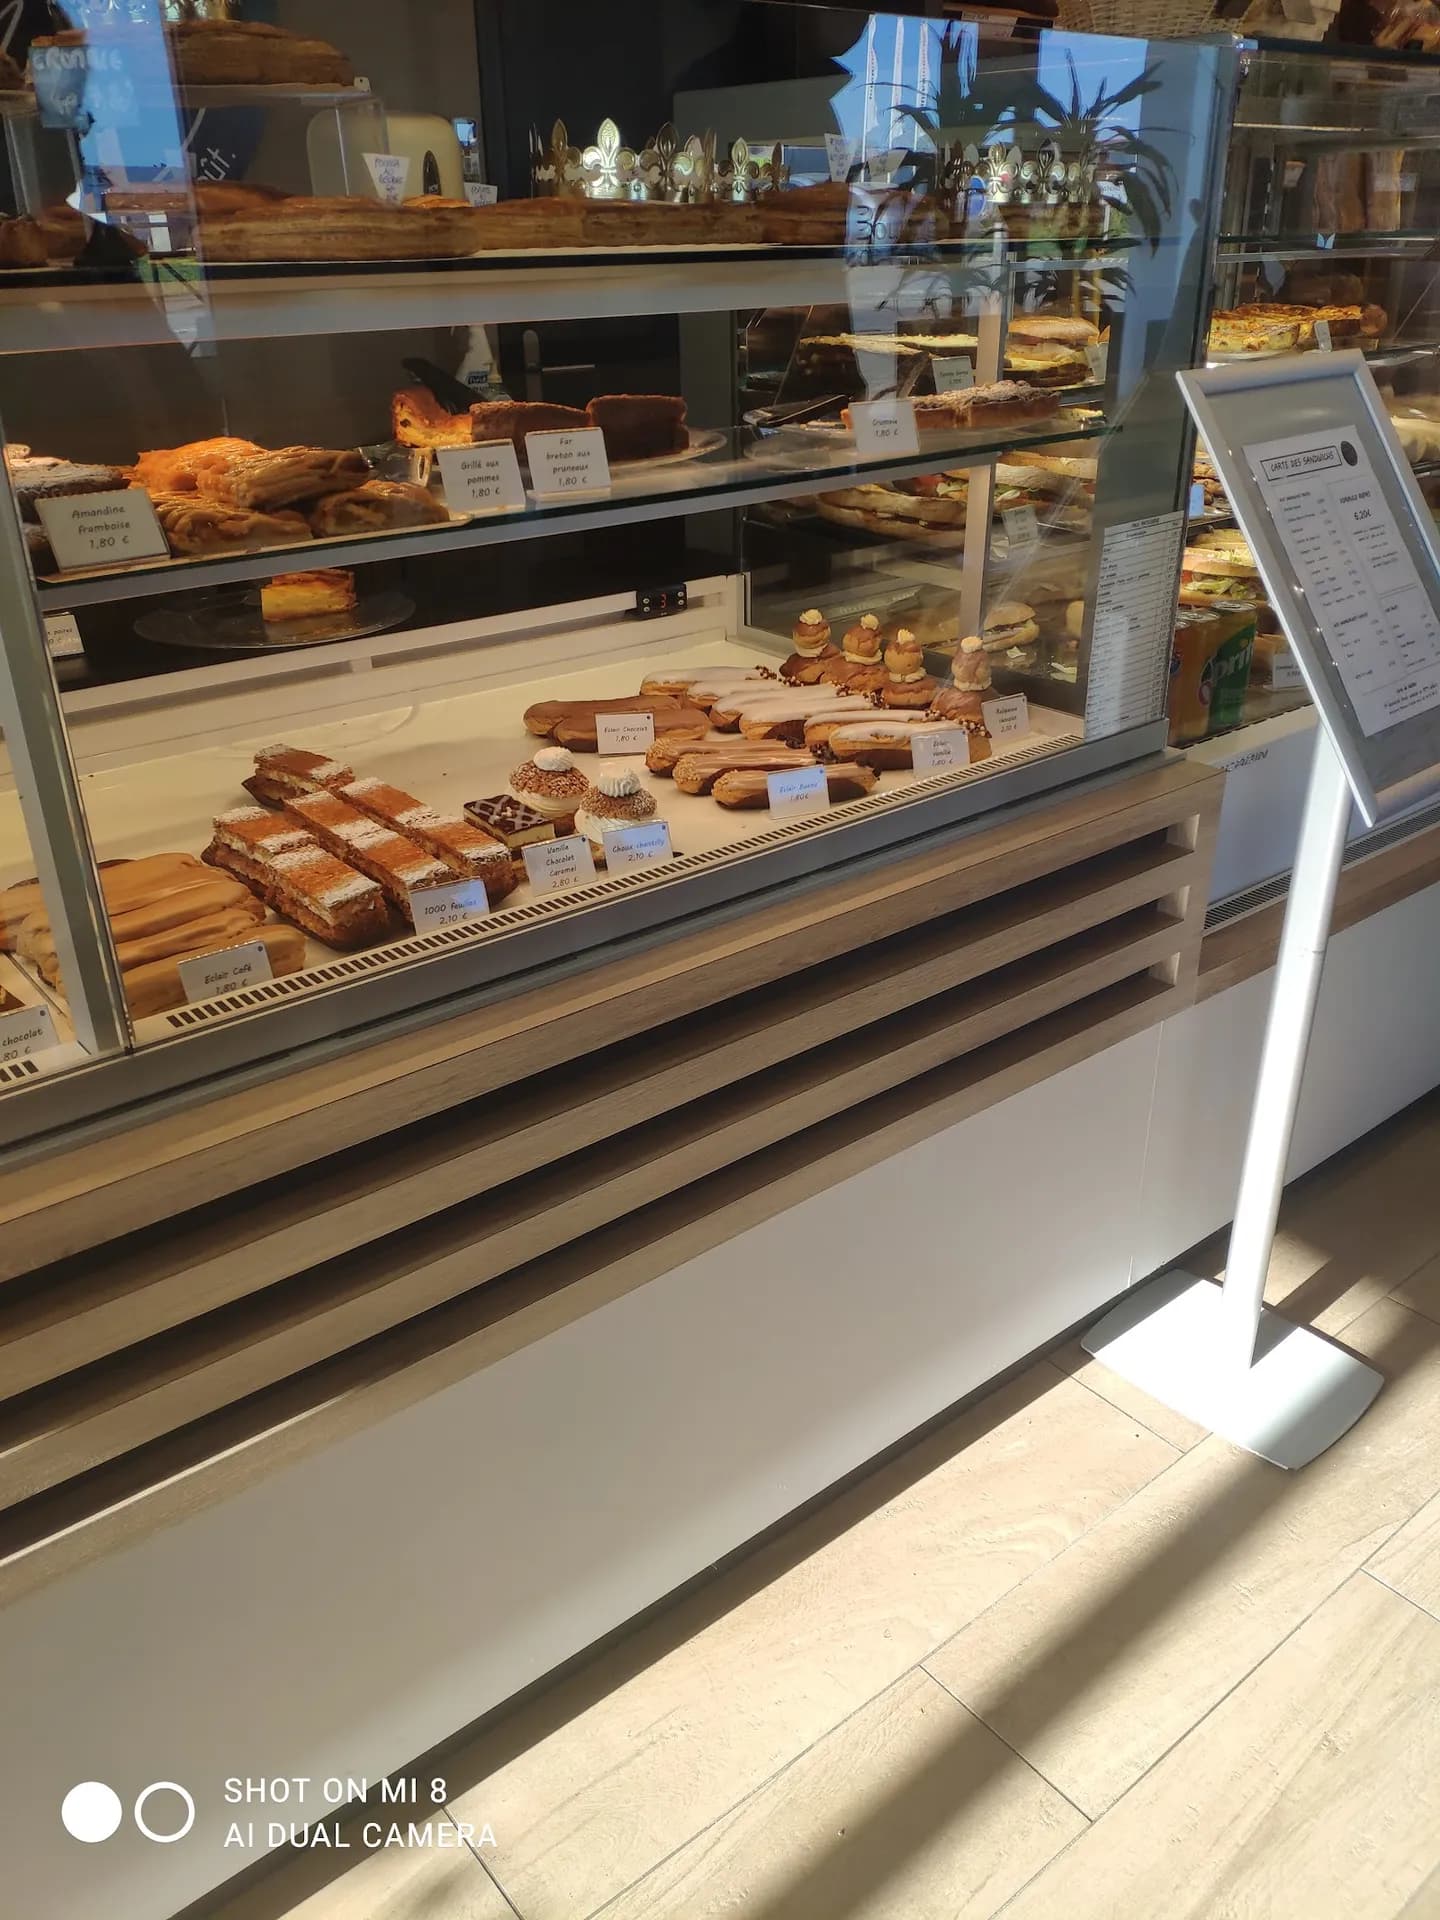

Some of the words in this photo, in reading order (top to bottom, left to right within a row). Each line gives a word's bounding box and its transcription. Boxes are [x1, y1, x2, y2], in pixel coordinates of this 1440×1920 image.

[560, 438, 573, 446] Far
[546, 451, 573, 461] breton
[461, 460, 482, 471] Grillé
[552, 464, 589, 474] pruneaux
[467, 475, 500, 486] pommes
[558, 477, 577, 487] 1,80
[471, 488, 490, 499] 1,80
[495, 487, 500, 495] €
[72, 505, 125, 519] Amandine
[78, 521, 131, 535] framboise
[89, 536, 116, 550] 1,80
[121, 535, 129, 544] €
[547, 844, 569, 854] Vanille
[545, 854, 575, 866] Chocolat
[549, 865, 577, 877] Caramel
[424, 904, 447, 915] 1000
[439, 914, 458, 925] 2,10
[462, 912, 468, 920] €
[204, 972, 229, 985] Eclair
[232, 963, 252, 976] Café
[215, 982, 236, 995] 1,80
[241, 978, 248, 987] €
[2, 1028, 43, 1047] chocolat
[24, 1045, 32, 1055] €
